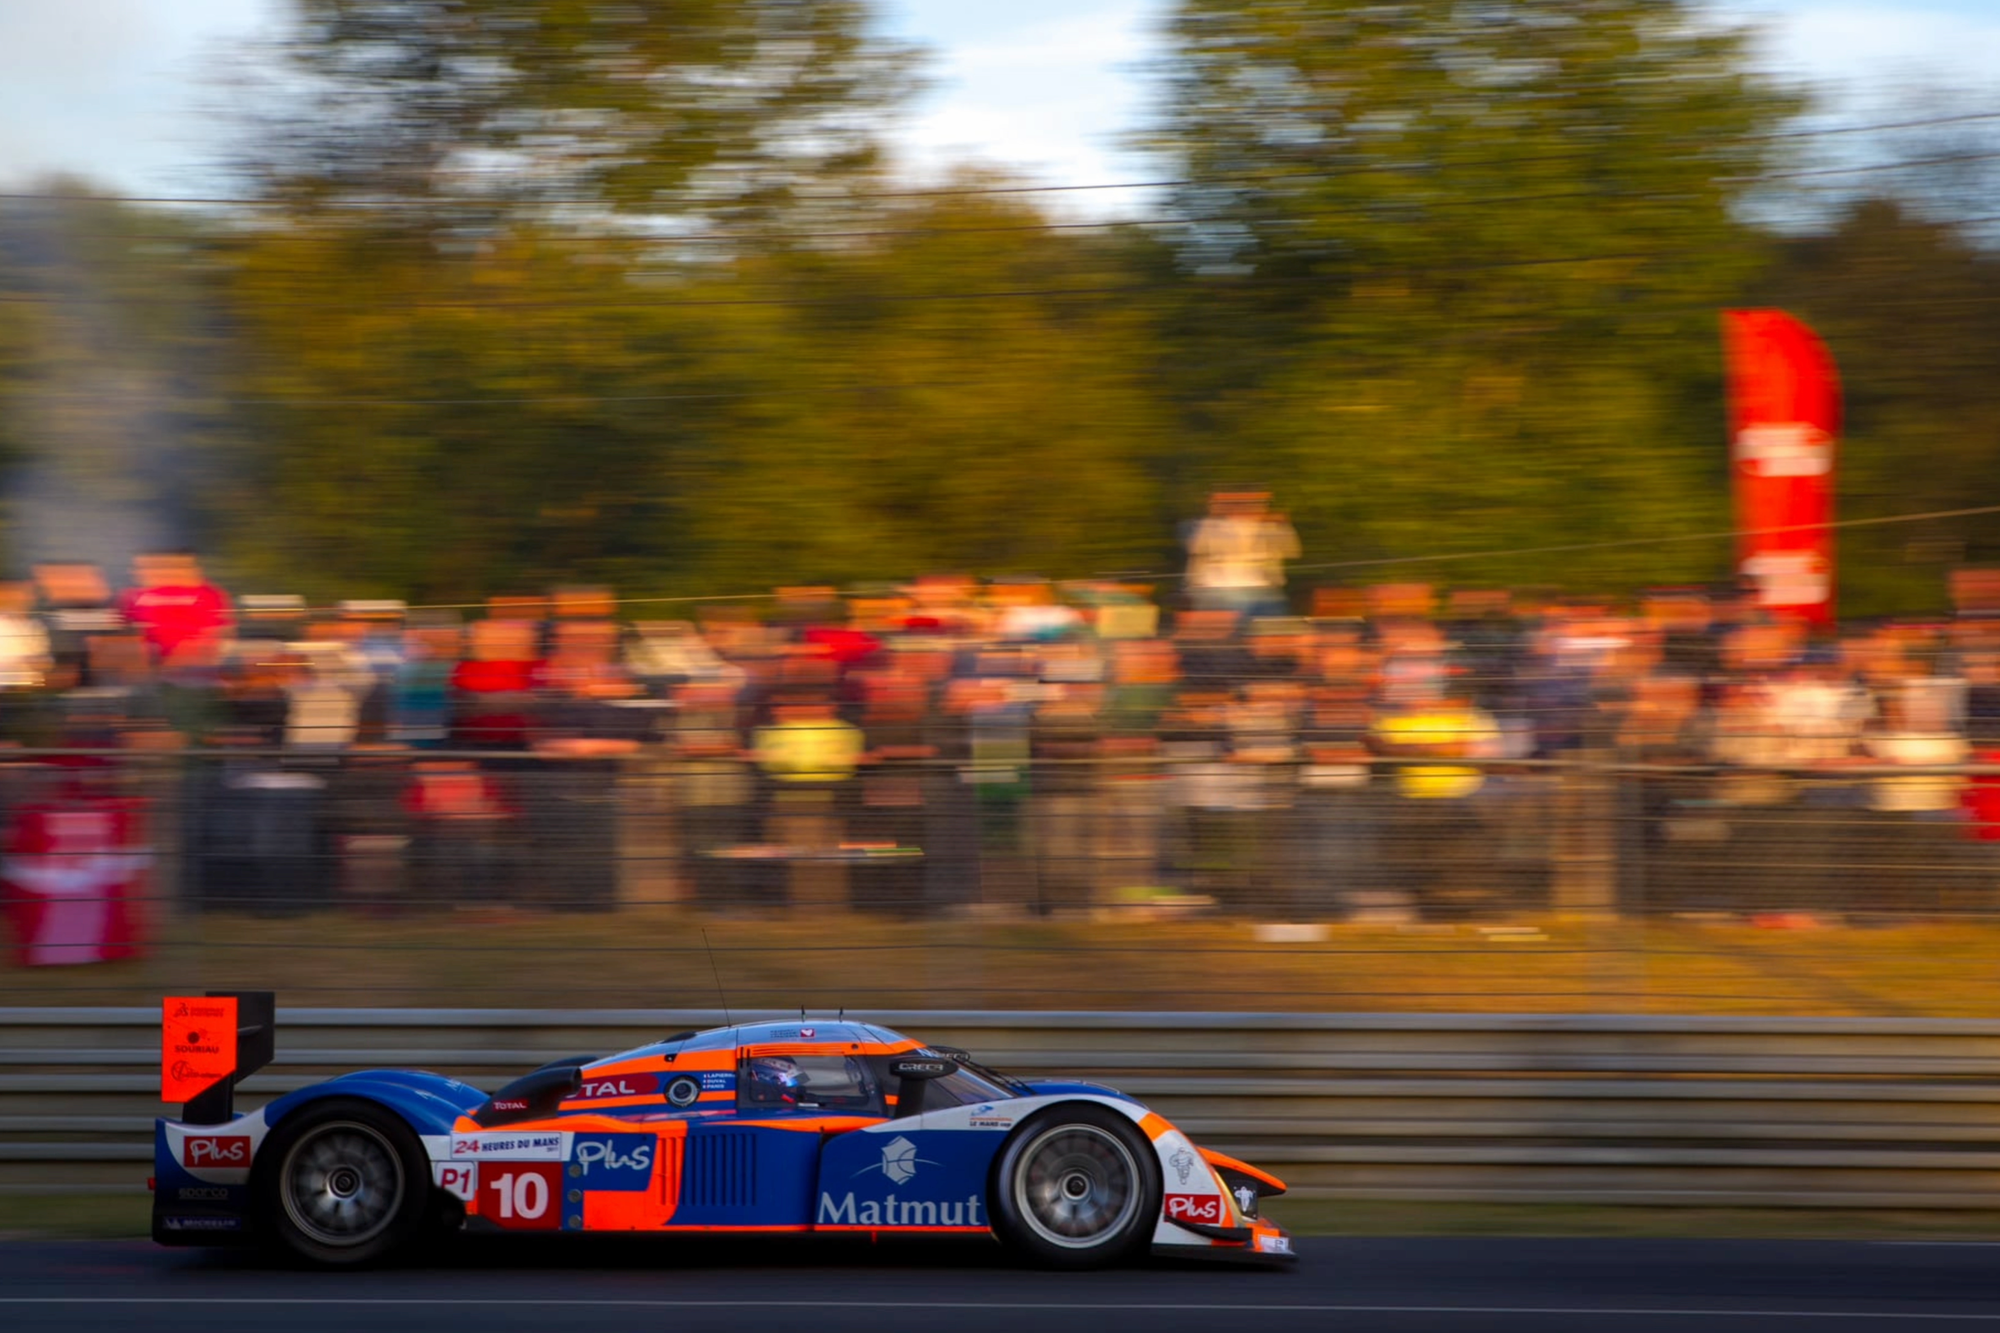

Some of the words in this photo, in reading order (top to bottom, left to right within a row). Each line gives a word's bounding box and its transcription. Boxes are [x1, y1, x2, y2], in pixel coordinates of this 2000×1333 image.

[175, 1045, 220, 1054] SOURIAU
[566, 1080, 636, 1099] TAL
[493, 1101, 527, 1110] TOTAL
[190, 1138, 244, 1165] Plus
[454, 1139, 479, 1154] 24
[481, 1141, 515, 1152] HEURES
[517, 1139, 531, 1149] DU
[533, 1137, 559, 1147] MANS
[576, 1139, 650, 1176] Plus
[440, 1168, 471, 1194] P1
[489, 1171, 549, 1219] 10
[1168, 1196, 1217, 1218] Plus
[817, 1191, 982, 1226] Matmut
